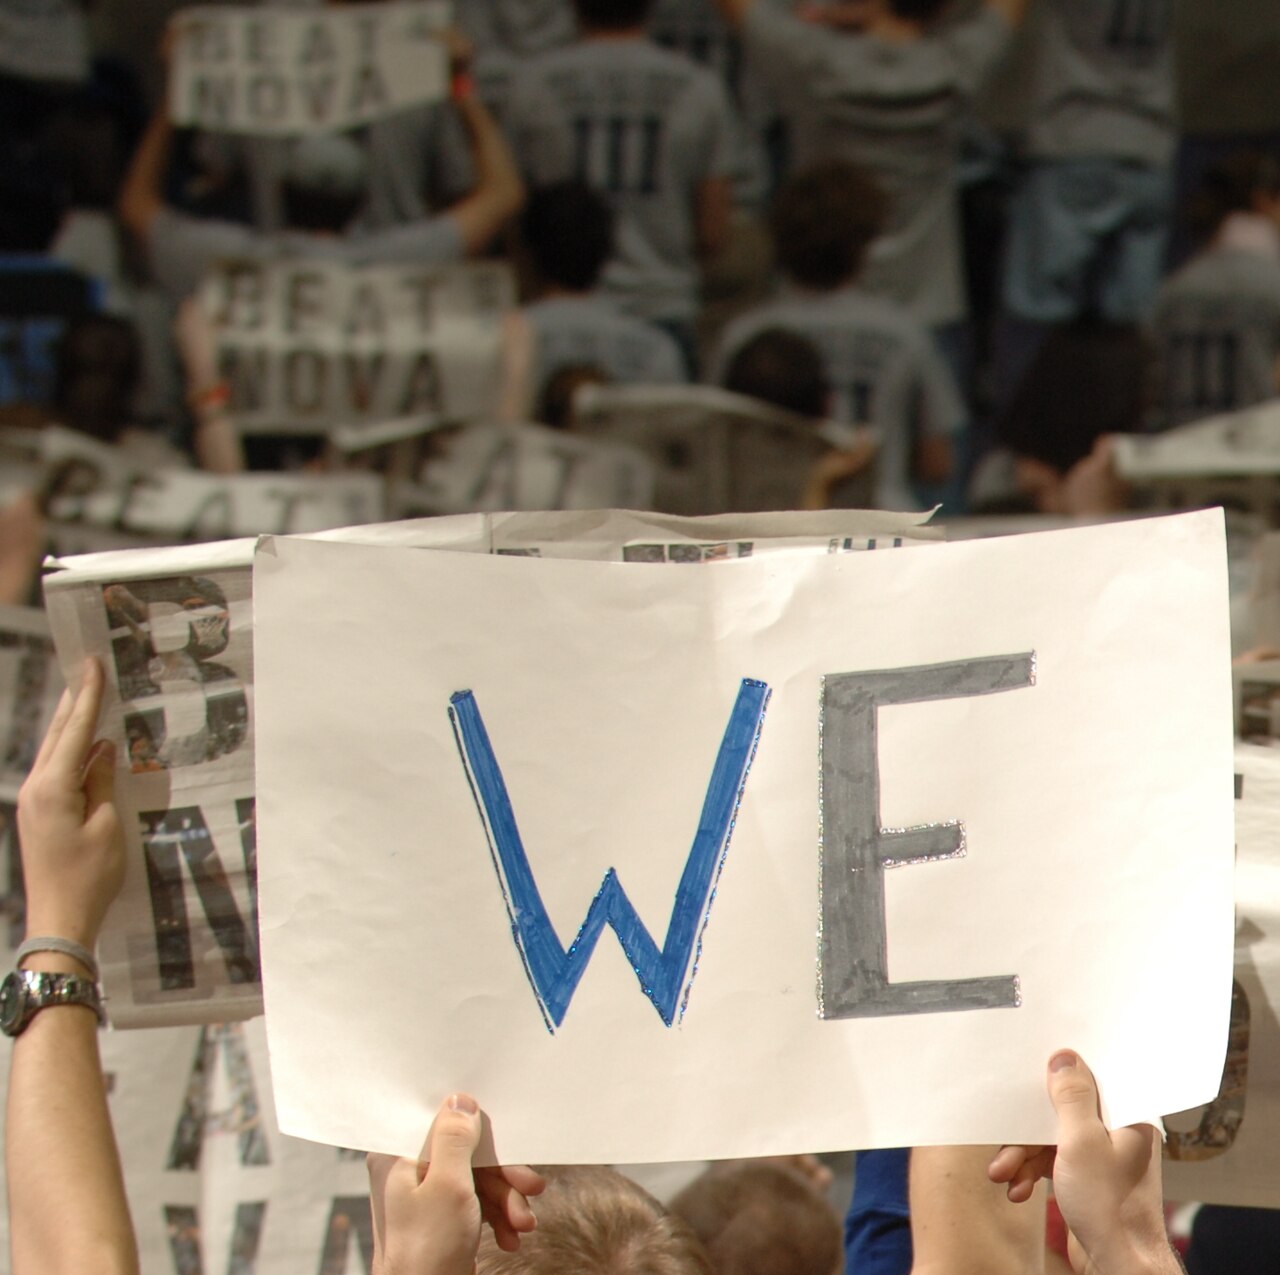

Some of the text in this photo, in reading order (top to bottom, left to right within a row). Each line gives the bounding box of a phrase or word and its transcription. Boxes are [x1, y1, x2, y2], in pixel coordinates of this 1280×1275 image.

[212, 262, 441, 332] BEAT
[215, 345, 444, 415] NOVA
[447, 648, 1037, 1036] WE
